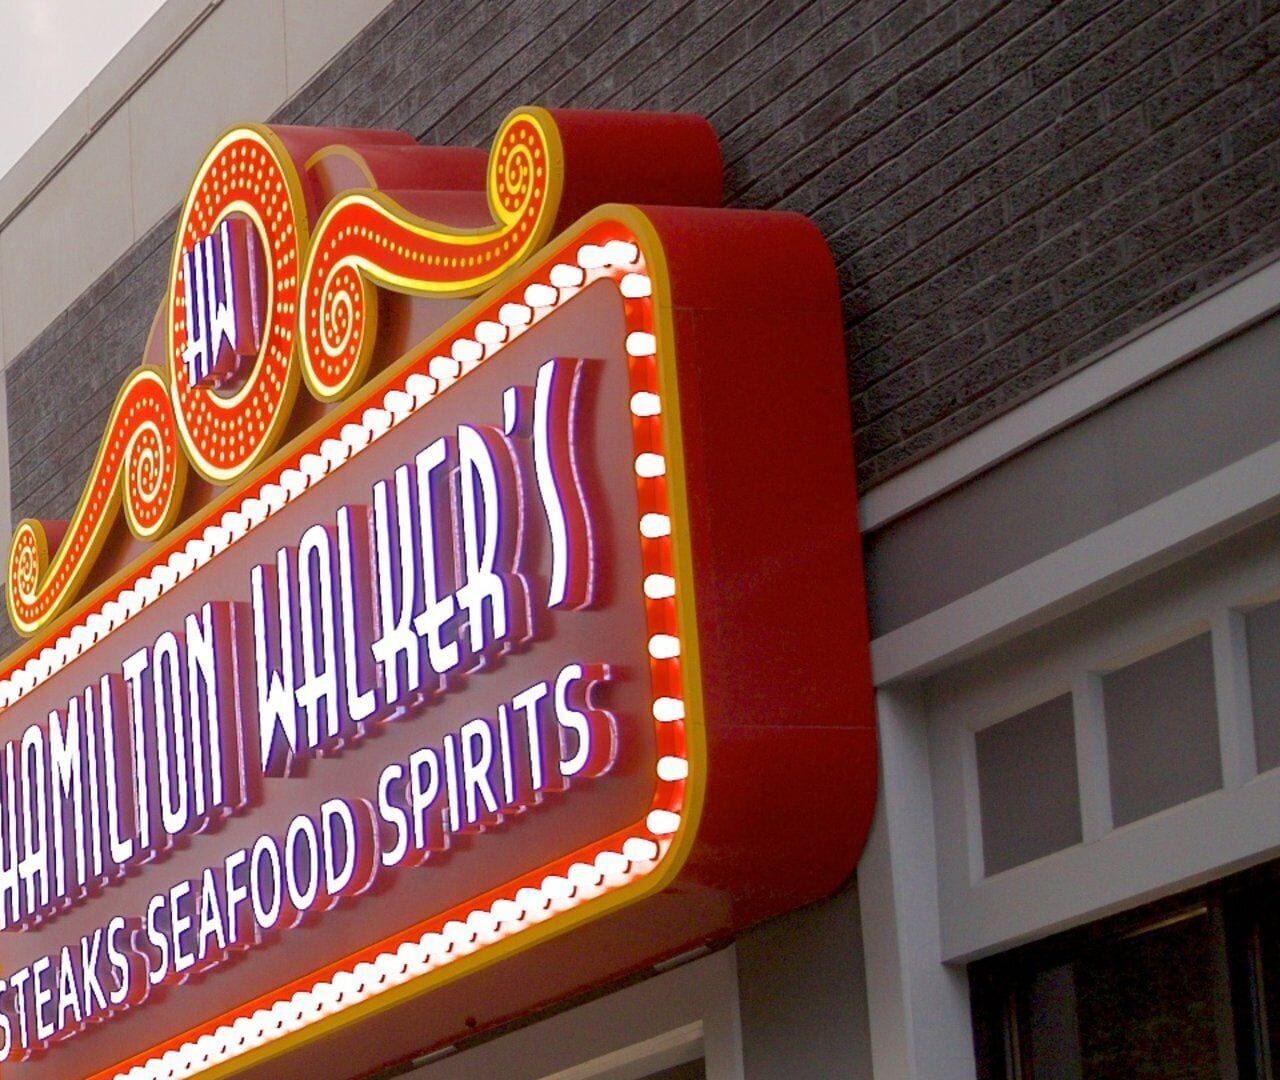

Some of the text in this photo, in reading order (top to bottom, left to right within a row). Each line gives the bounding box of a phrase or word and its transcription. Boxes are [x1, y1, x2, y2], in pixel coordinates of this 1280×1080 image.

[182, 219, 238, 389] HW
[250, 358, 570, 773] WALKER'S
[146, 797, 355, 985] SEAFOOD
[377, 663, 590, 868] SPIRITS
